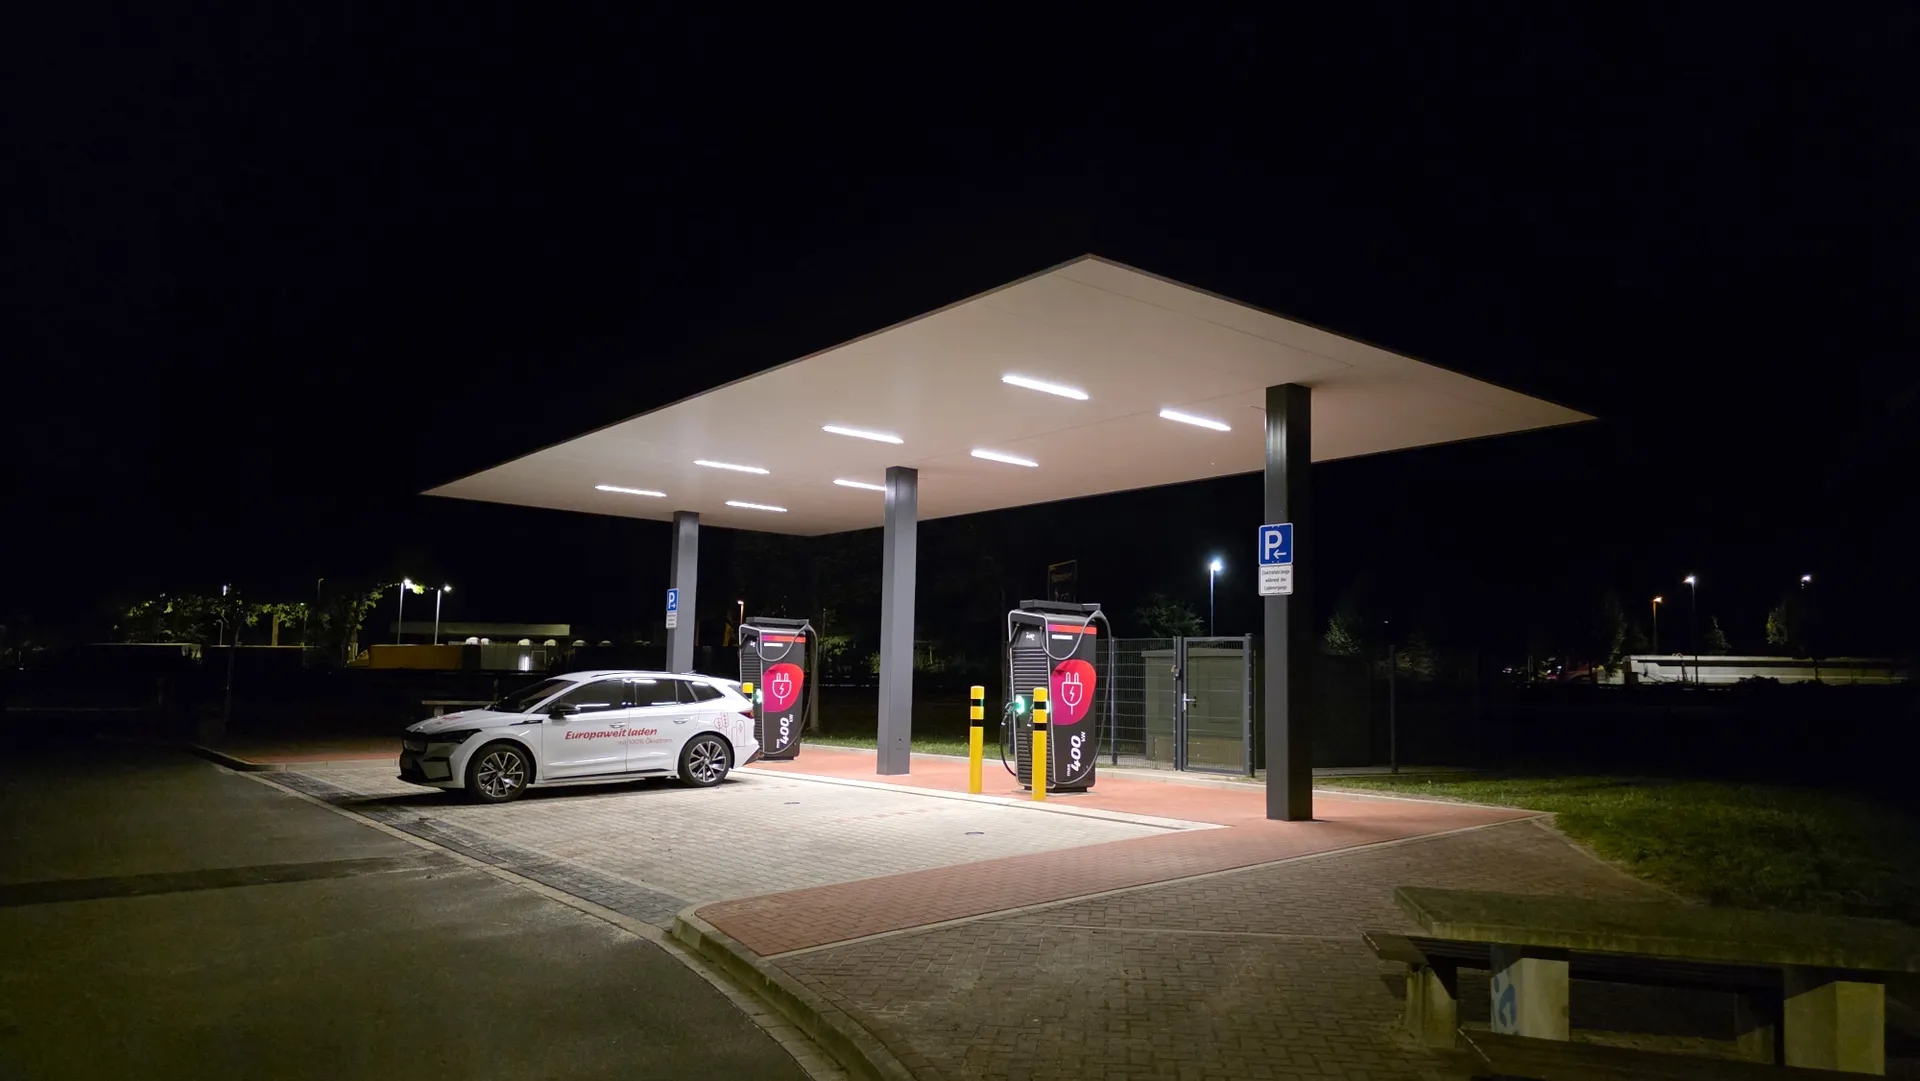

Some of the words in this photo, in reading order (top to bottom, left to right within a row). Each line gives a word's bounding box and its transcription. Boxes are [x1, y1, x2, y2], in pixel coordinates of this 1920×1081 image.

[1265, 530, 1283, 560] P
[668, 591, 676, 610] P
[565, 728, 626, 740] Europaweit
[628, 727, 658, 737] laden
[779, 717, 789, 745] 400
[1070, 735, 1081, 772] 400
[1080, 731, 1086, 742] kW
